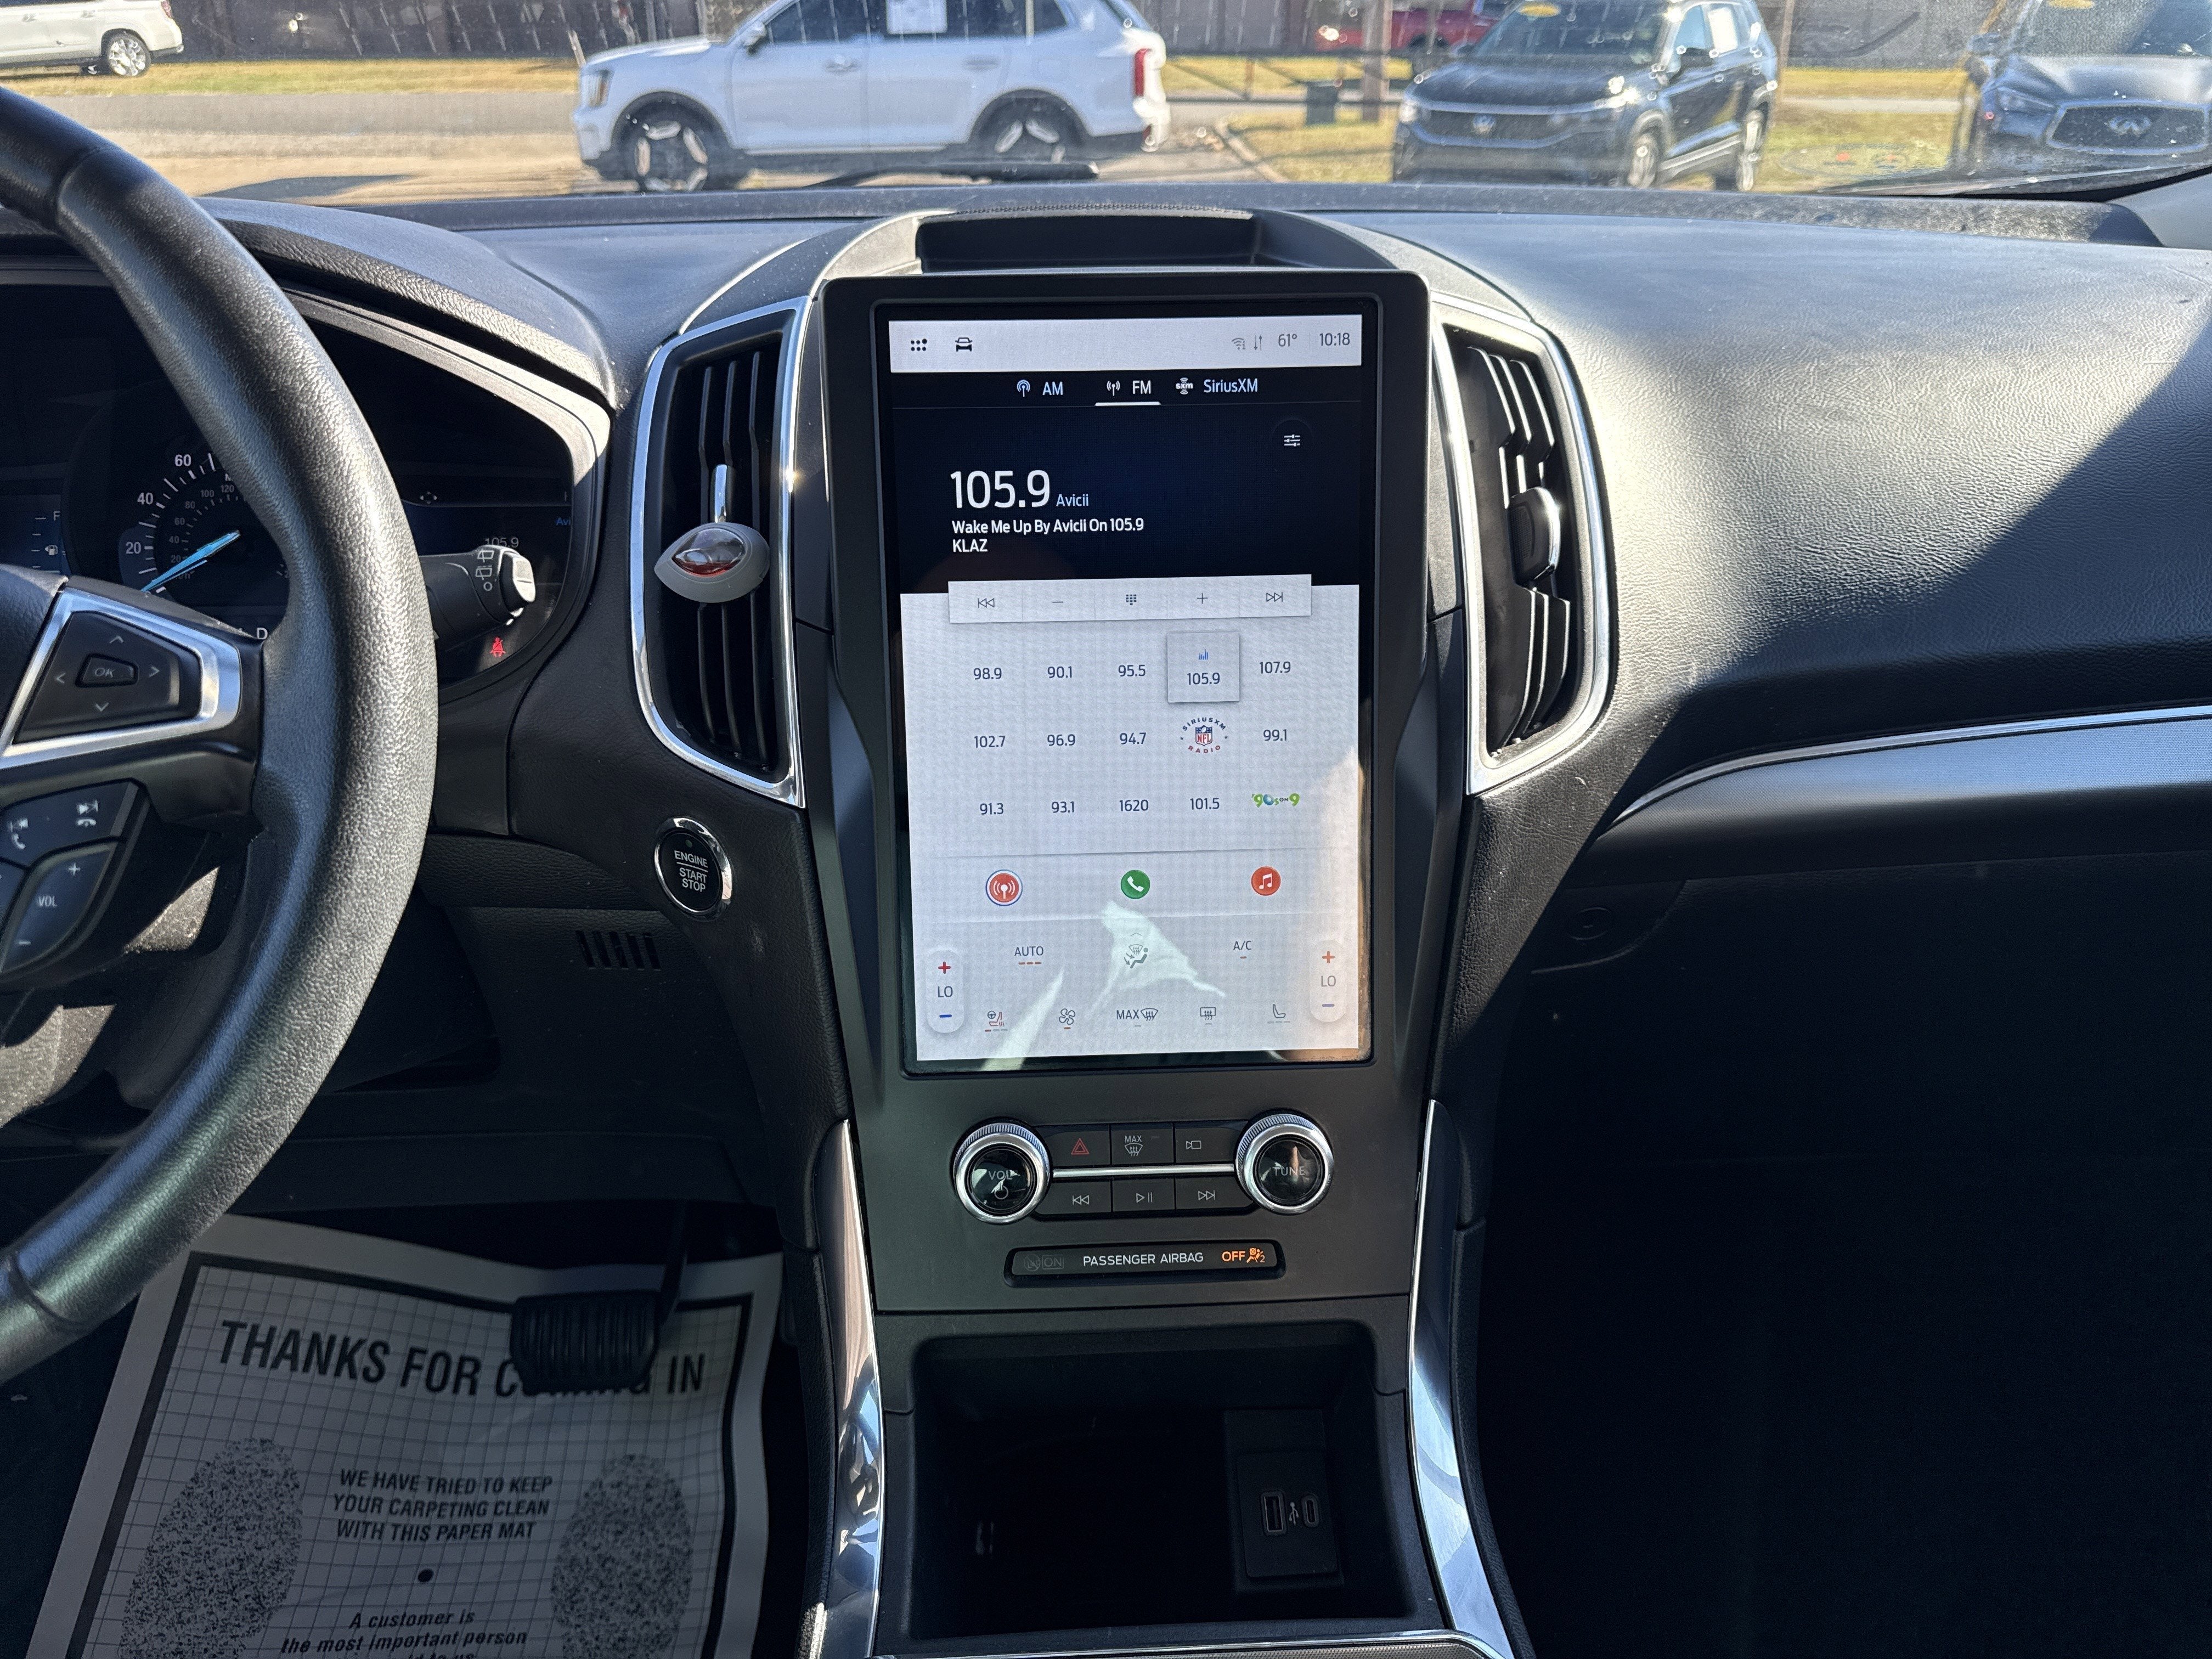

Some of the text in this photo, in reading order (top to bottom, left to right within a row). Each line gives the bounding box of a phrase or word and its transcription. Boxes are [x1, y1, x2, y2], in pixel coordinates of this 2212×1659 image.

[1278, 333, 1297, 347] 61°
[1319, 332, 1350, 346] 10:18
[1042, 381, 1063, 396] AM
[1132, 380, 1151, 394] FM
[1203, 378, 1258, 393] SiriusXM
[174, 454, 191, 467] 60
[200, 489, 215, 498] 100
[220, 484, 235, 493] 120
[950, 470, 1089, 509] 105.9 Avicii
[137, 492, 154, 505] 40
[184, 500, 196, 510] 80
[53, 511, 60, 521] F
[174, 517, 185, 526] 60
[951, 517, 1144, 535] Wake Me Up By Avicii On 105.9
[168, 535, 179, 544] 40
[952, 538, 989, 552] KLAZ
[126, 541, 142, 554] 20
[257, 627, 268, 640] D
[94, 667, 114, 677] OK
[973, 667, 1002, 680] 98.9
[1047, 665, 1073, 679] 90.1
[1118, 664, 1146, 677] 95.5
[1259, 661, 1291, 674] 107.9
[1187, 672, 1220, 685] 105.9
[1182, 718, 1226, 731] SIRIUSXM
[974, 735, 1006, 748] 102.7
[1047, 733, 1076, 747] 96.9
[1120, 732, 1147, 745] 94.7
[1197, 734, 1211, 743] NFL
[1263, 729, 1287, 742] 99.1
[1188, 745, 1220, 753] RADIO
[1119, 799, 1149, 812] 1620
[1189, 797, 1220, 810] 101.5
[1289, 793, 1300, 806] 9
[979, 803, 1004, 815] 91.3
[1051, 801, 1075, 814] 93.1
[674, 850, 708, 868] ENGINE
[679, 867, 707, 883] START
[682, 878, 706, 892] STOP
[38, 895, 57, 907] VOL
[1014, 946, 1044, 957] AUTO
[1233, 940, 1252, 951] A/C
[1321, 975, 1336, 988] LO
[937, 986, 953, 998] LO
[1116, 1009, 1139, 1020] MAX
[1125, 1135, 1142, 1143] MAX
[988, 1171, 1012, 1181] VOL
[1273, 1166, 1305, 1176] TUNE
[1083, 1254, 1156, 1267] PASSENGER
[1160, 1252, 1204, 1263] AIRBAG
[1222, 1251, 1246, 1262] OFF
[219, 1321, 391, 1384] THANKS
[400, 1348, 481, 1397] FOR
[667, 1353, 706, 1395] IN
[340, 1469, 553, 1494] WE HAVE TRIED TO KEEP
[334, 1494, 550, 1517] YOUR CARPETING CLEAN
[337, 1520, 535, 1542] WITH THIS PAPER MAT
[349, 1610, 475, 1628] A customer is
[281, 1631, 527, 1654] the most important person
